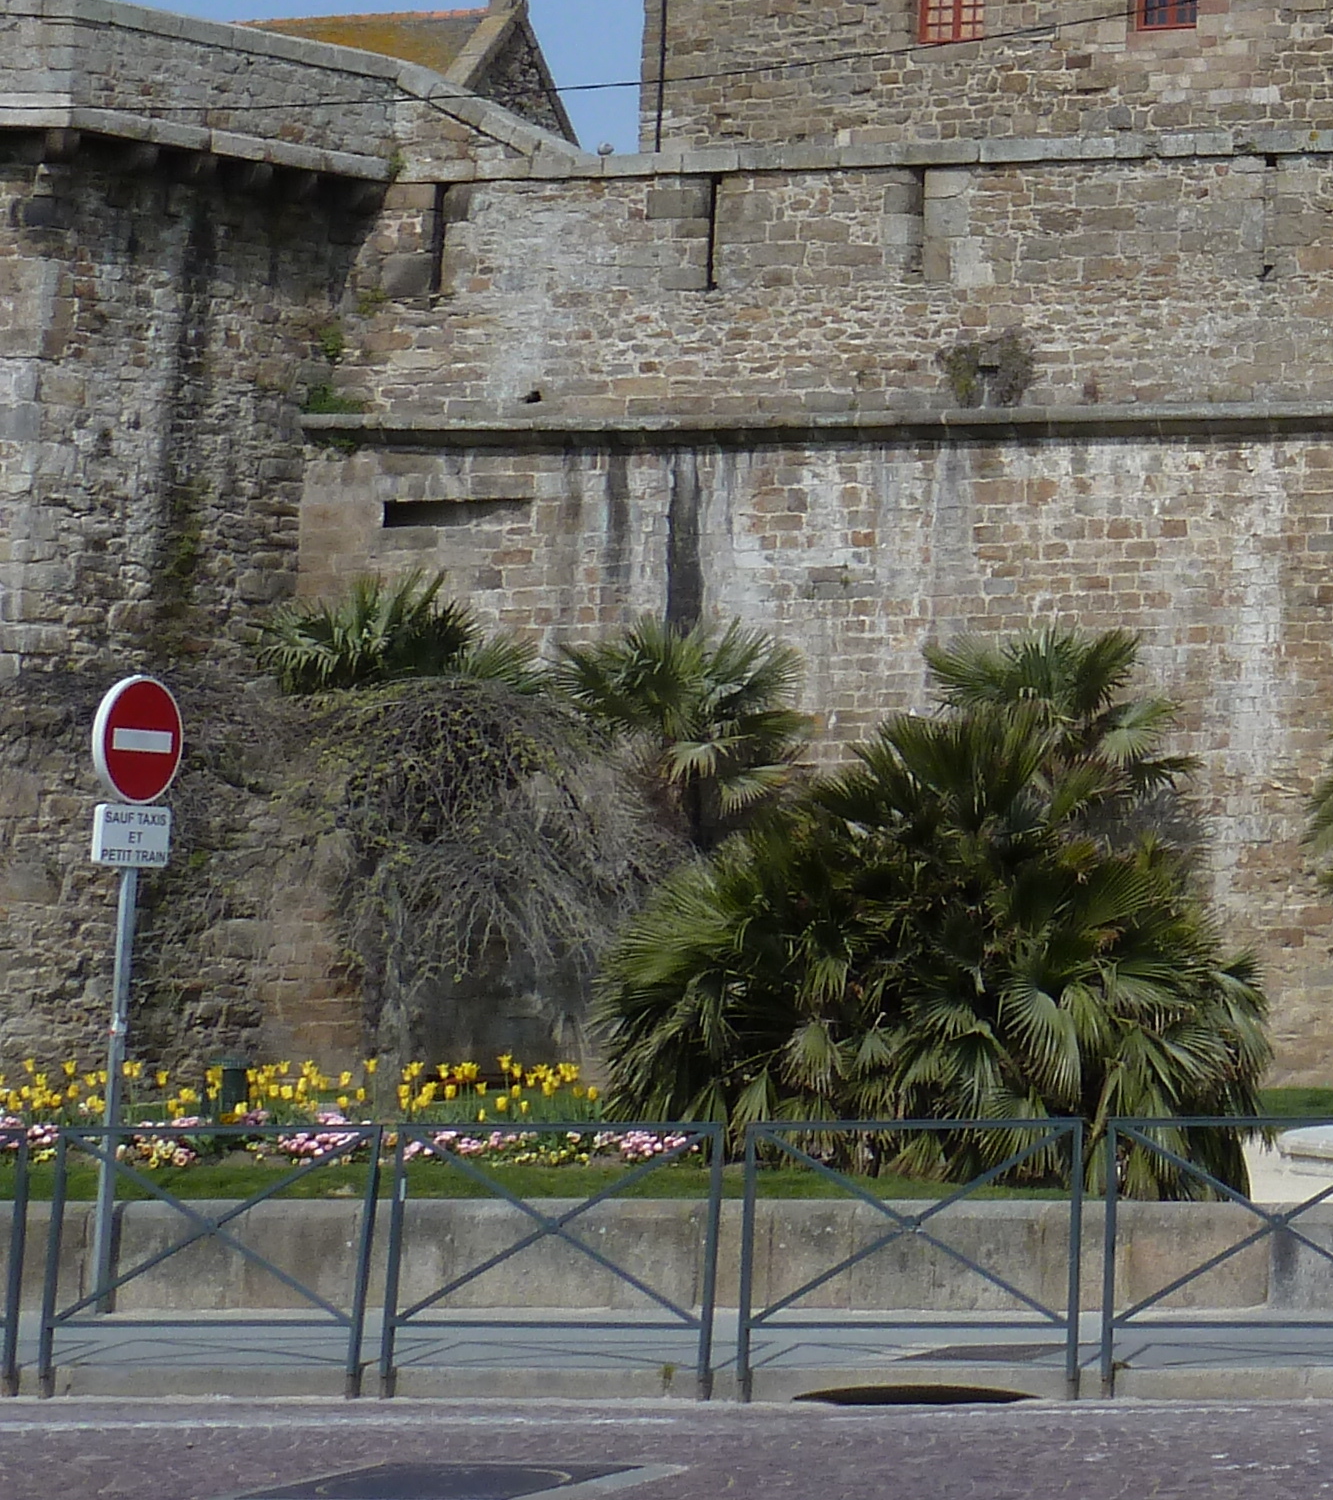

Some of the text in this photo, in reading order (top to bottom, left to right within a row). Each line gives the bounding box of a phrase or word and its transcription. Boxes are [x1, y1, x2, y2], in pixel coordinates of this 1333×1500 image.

[105, 811, 167, 826] SAUF TAXIS
[128, 832, 143, 844] ET
[101, 849, 165, 863] PETIT TRAIN
